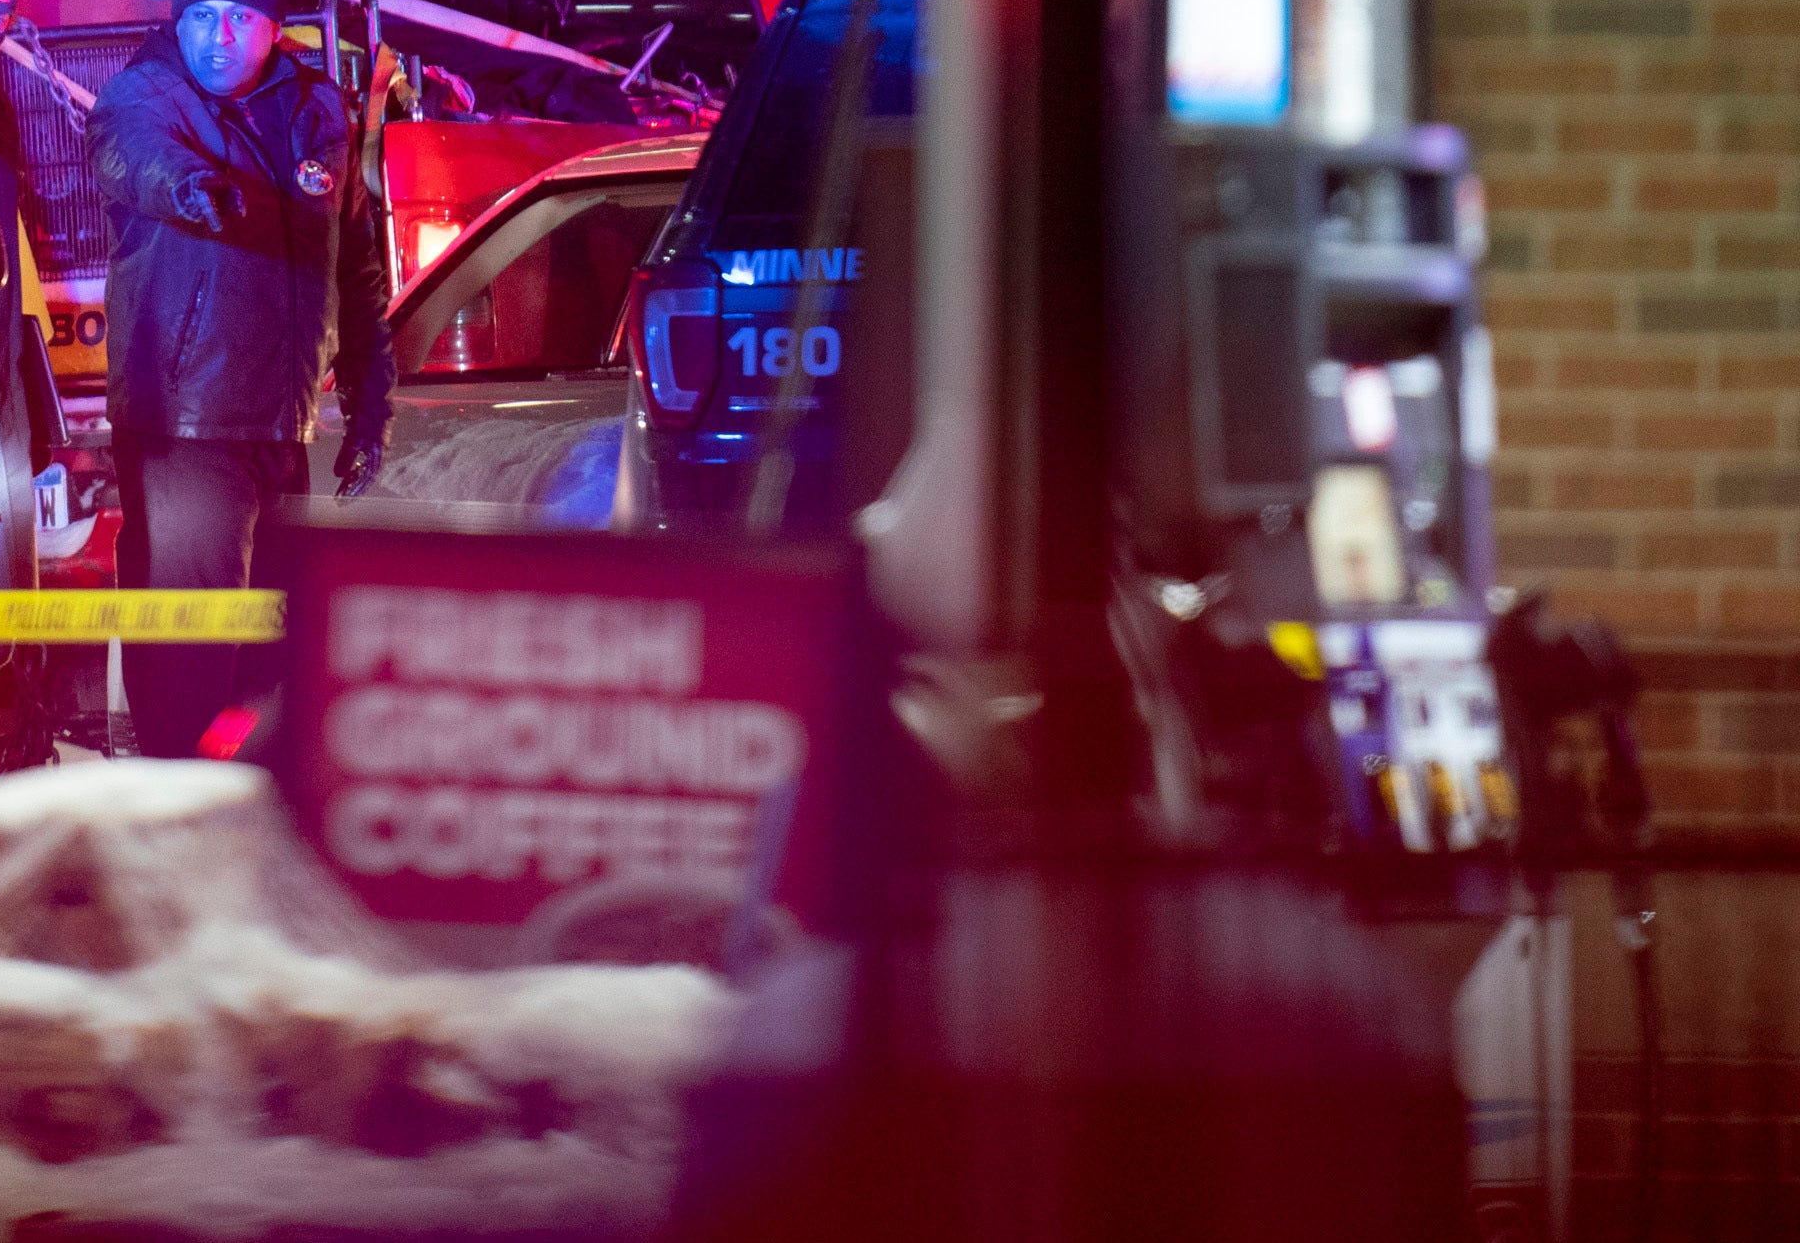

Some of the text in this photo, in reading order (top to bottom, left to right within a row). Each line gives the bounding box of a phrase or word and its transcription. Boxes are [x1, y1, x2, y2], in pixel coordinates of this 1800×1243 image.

[727, 325, 842, 377] 180
[326, 584, 706, 696] FRESH
[322, 685, 808, 798] GROUND
[322, 781, 762, 892] COFFEE
